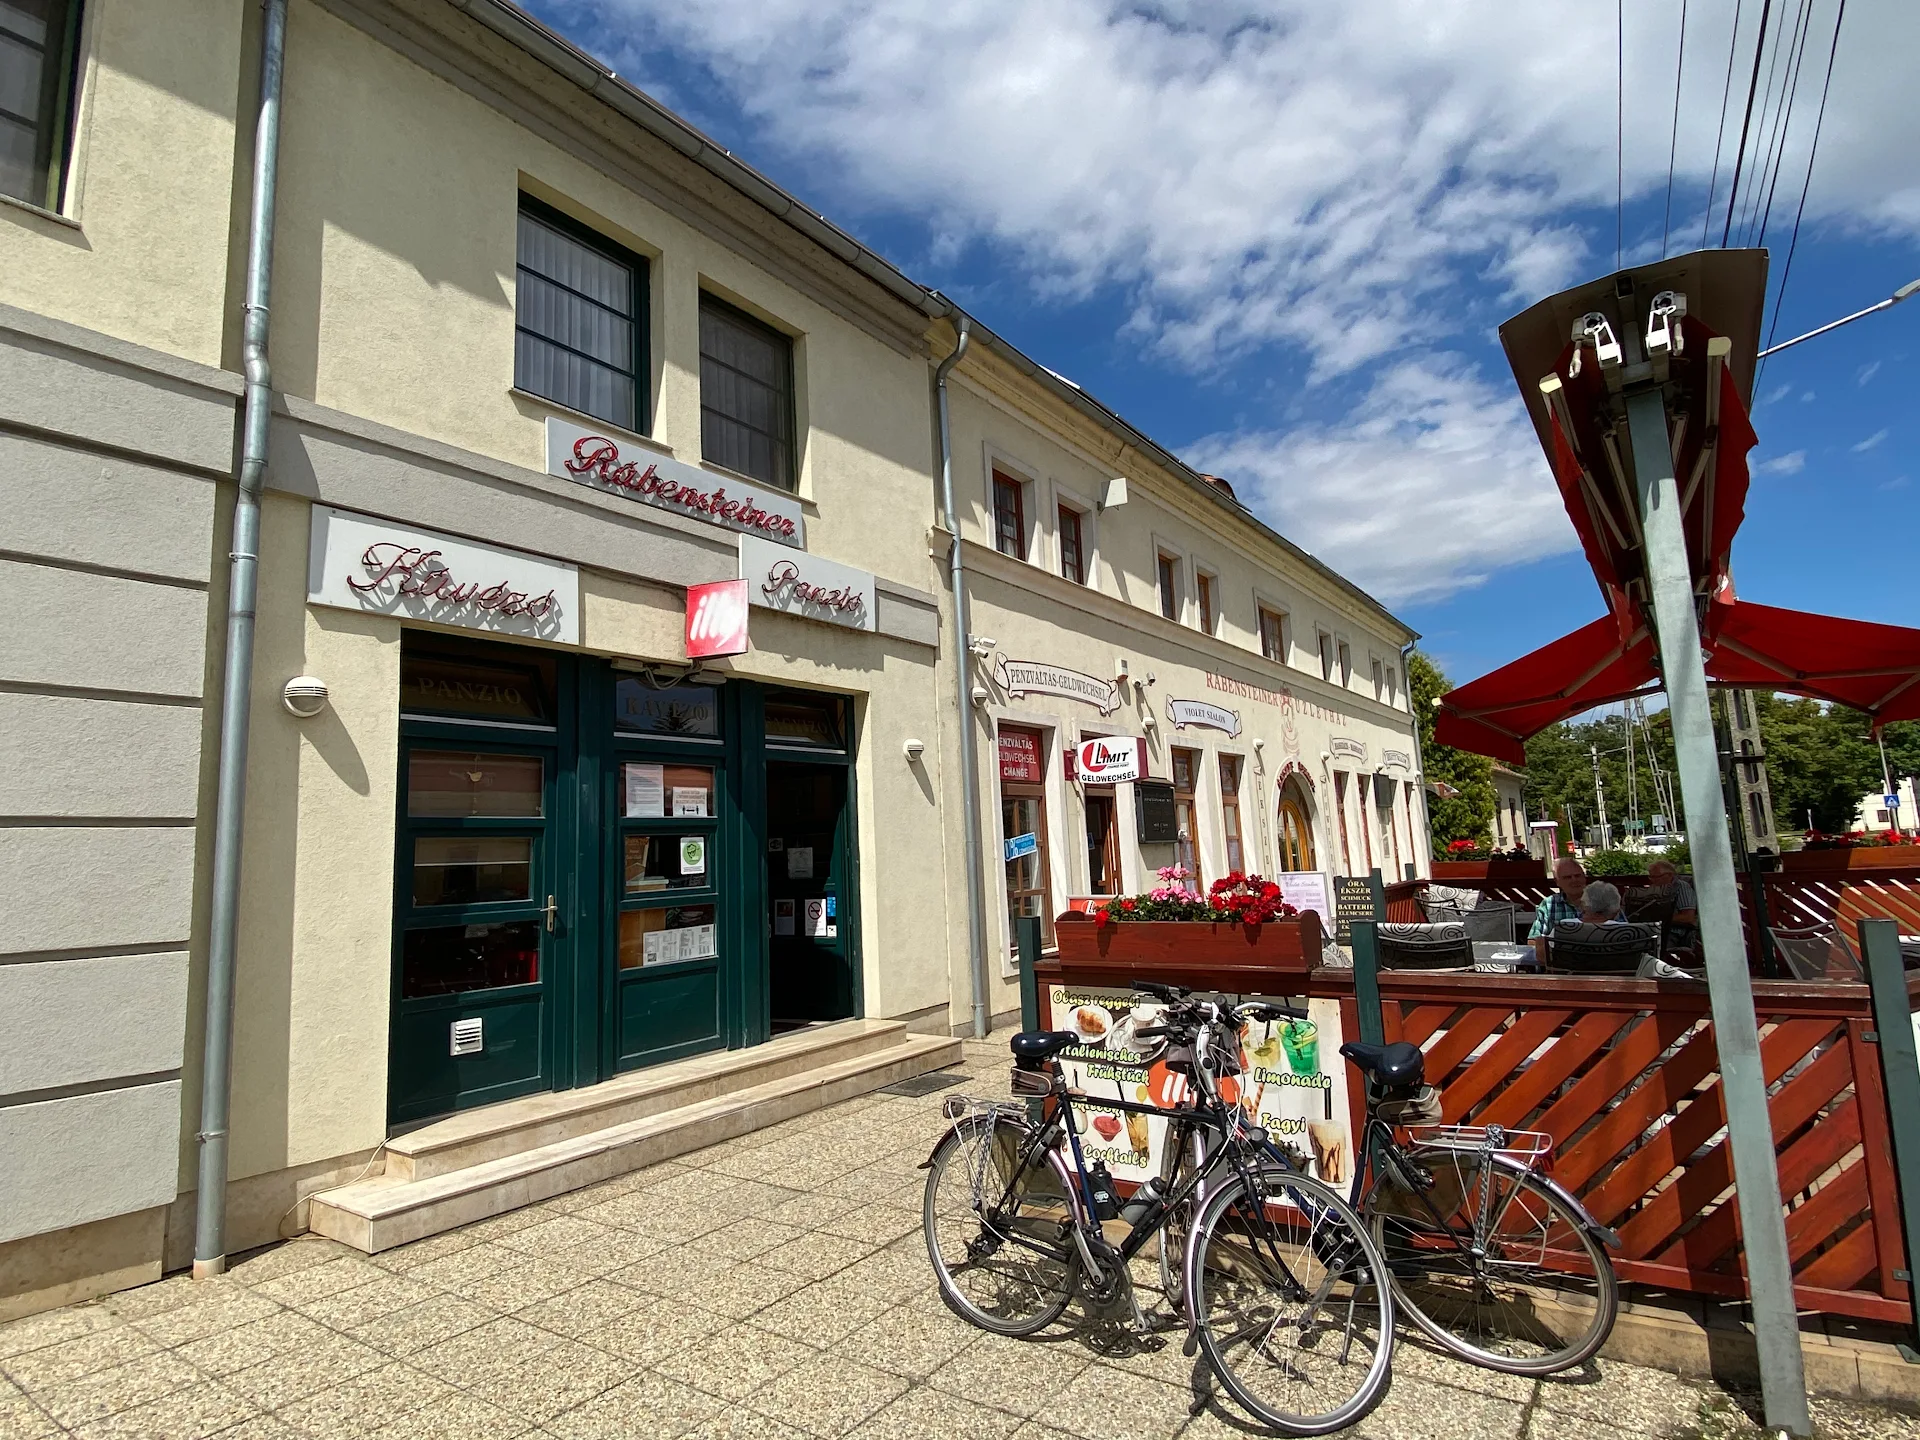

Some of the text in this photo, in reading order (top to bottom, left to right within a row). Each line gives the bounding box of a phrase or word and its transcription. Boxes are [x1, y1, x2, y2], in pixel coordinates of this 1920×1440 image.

[564, 436, 796, 536] Rábensteiner
[346, 542, 556, 618] Kávézó
[761, 559, 863, 612] Panzió
[689, 591, 744, 649] illy
[417, 676, 523, 706] PANZIÓ
[1010, 665, 1108, 702] PÉNZVÁLTÁS-GELDWECHSEL
[1206, 667, 1279, 707] RÁBENSTEINER
[1184, 707, 1205, 718] VIOLET
[998, 734, 1033, 750] ÉNZVÁLTÁS
[1095, 742, 1130, 764] LIMIT
[998, 751, 1037, 765] ELDWECHSEL
[1003, 766, 1029, 778] CHANGE
[1081, 770, 1137, 783] GELDWECHSEL
[1340, 886, 1372, 895] ÉKSZER
[1347, 880, 1365, 888] ÓRA
[1053, 988, 1141, 1011] Olasz reggeli
[1086, 1063, 1151, 1087] Frühstück
[1254, 1067, 1332, 1089] Limonade
[1261, 1112, 1307, 1135] Fagyi
[1082, 1143, 1148, 1169] Cocktails
